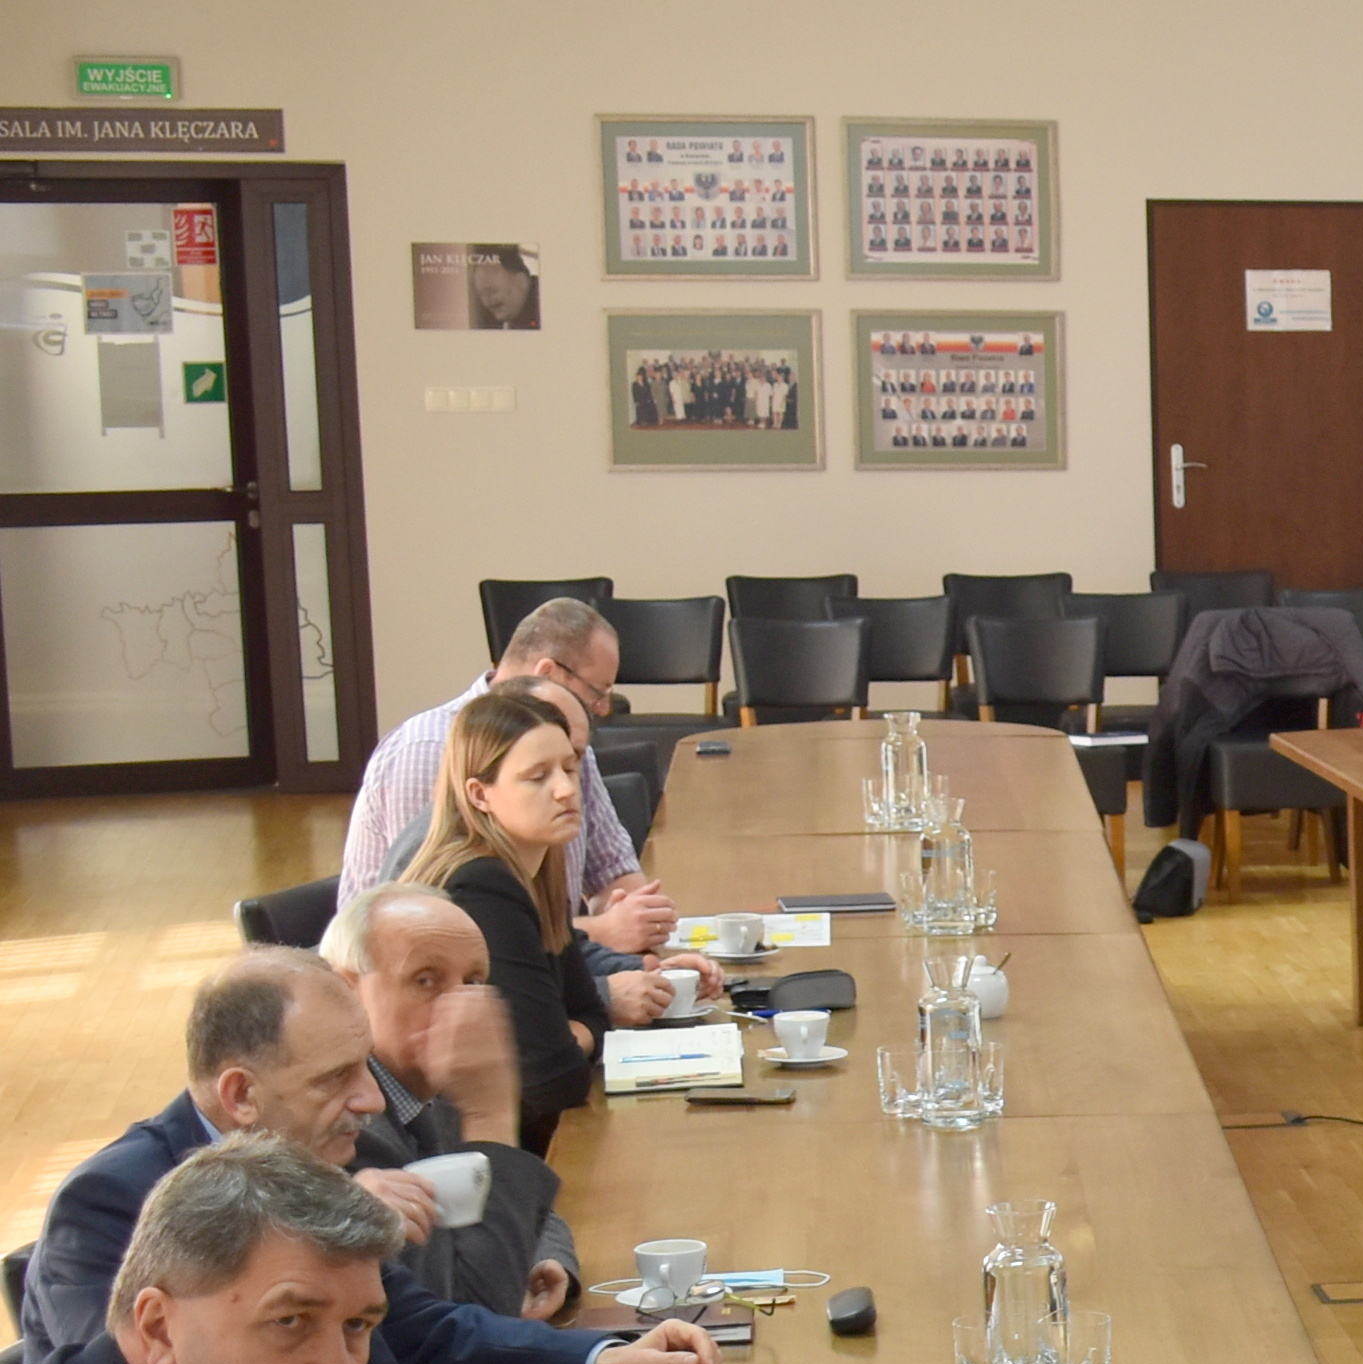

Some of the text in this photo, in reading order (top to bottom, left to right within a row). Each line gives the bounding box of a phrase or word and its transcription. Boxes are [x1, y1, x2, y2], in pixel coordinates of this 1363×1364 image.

[87, 66, 163, 83] WYJŚCIE
[83, 82, 167, 93] EWAKUACYJNE
[0, 121, 259, 143] SALA IM. JANA KLĘCZARA
